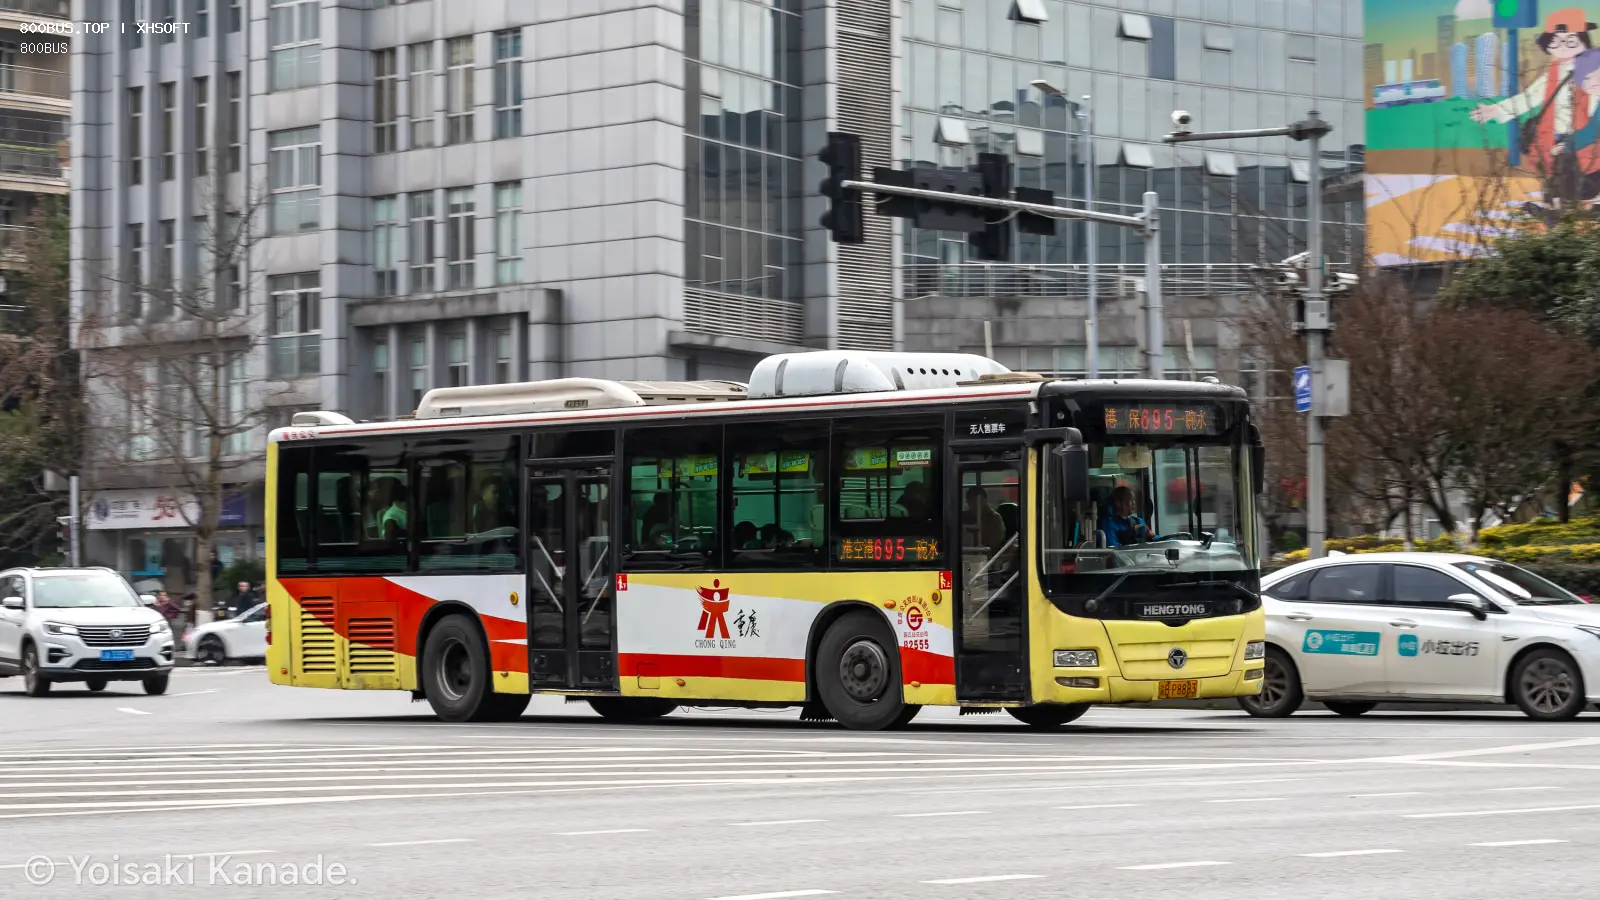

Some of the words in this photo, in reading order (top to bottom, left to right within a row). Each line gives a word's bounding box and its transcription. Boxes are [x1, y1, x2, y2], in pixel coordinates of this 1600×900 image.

[970, 423, 1006, 434] 无人售票车
[1143, 604, 1206, 616] HENGTONG
[695, 640, 716, 649] CHONG
[719, 640, 737, 650] QING
[903, 639, 930, 651] 82555
[1421, 639, 1479, 656] 小拉出行
